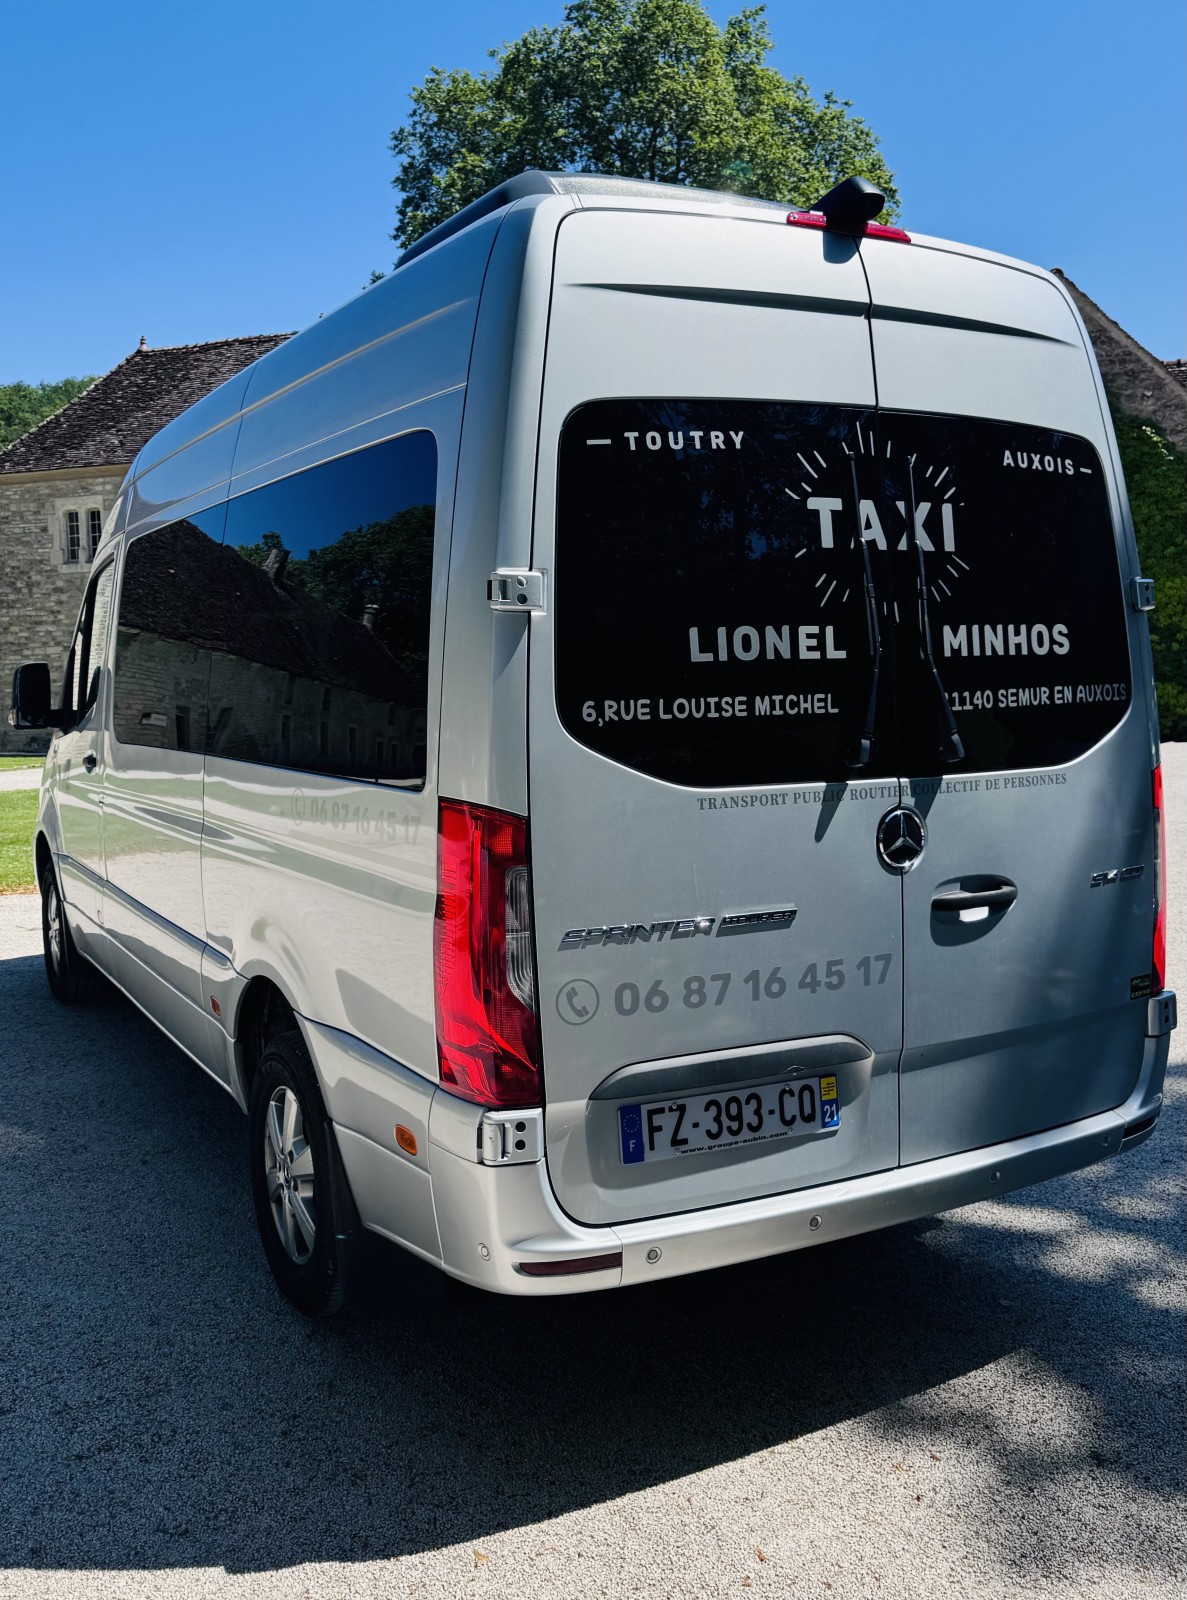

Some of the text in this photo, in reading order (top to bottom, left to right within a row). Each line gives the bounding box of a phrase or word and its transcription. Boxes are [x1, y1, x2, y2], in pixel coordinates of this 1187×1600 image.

[623, 430, 744, 451] TOUTRY
[1003, 450, 1075, 475] AUXOIS
[806, 497, 955, 552] TAXI
[688, 623, 1070, 662] LIONEL MINHOS
[658, 696, 748, 720] LOUISE
[754, 693, 839, 716] MICHEL
[998, 687, 1050, 707] SEMUR
[1054, 685, 1073, 704] EN
[1076, 683, 1127, 703] AUXOIS
[696, 772, 1067, 811] TRANSPORT PUBLIC ROUTIER COLLECTIF DE PERSONNES
[310, 799, 327, 826] 06
[331, 801, 349, 830] 87
[353, 806, 370, 836] 16
[402, 815, 421, 846] 17
[561, 916, 716, 946] SPRINTER
[613, 953, 893, 1016] 06 87 16 45 17
[646, 1083, 817, 1151] FZ-393-CQ
[823, 1103, 838, 1123] 21
[629, 1139, 636, 1152] F
[680, 1131, 788, 1154] www.groupe-aubin.com
